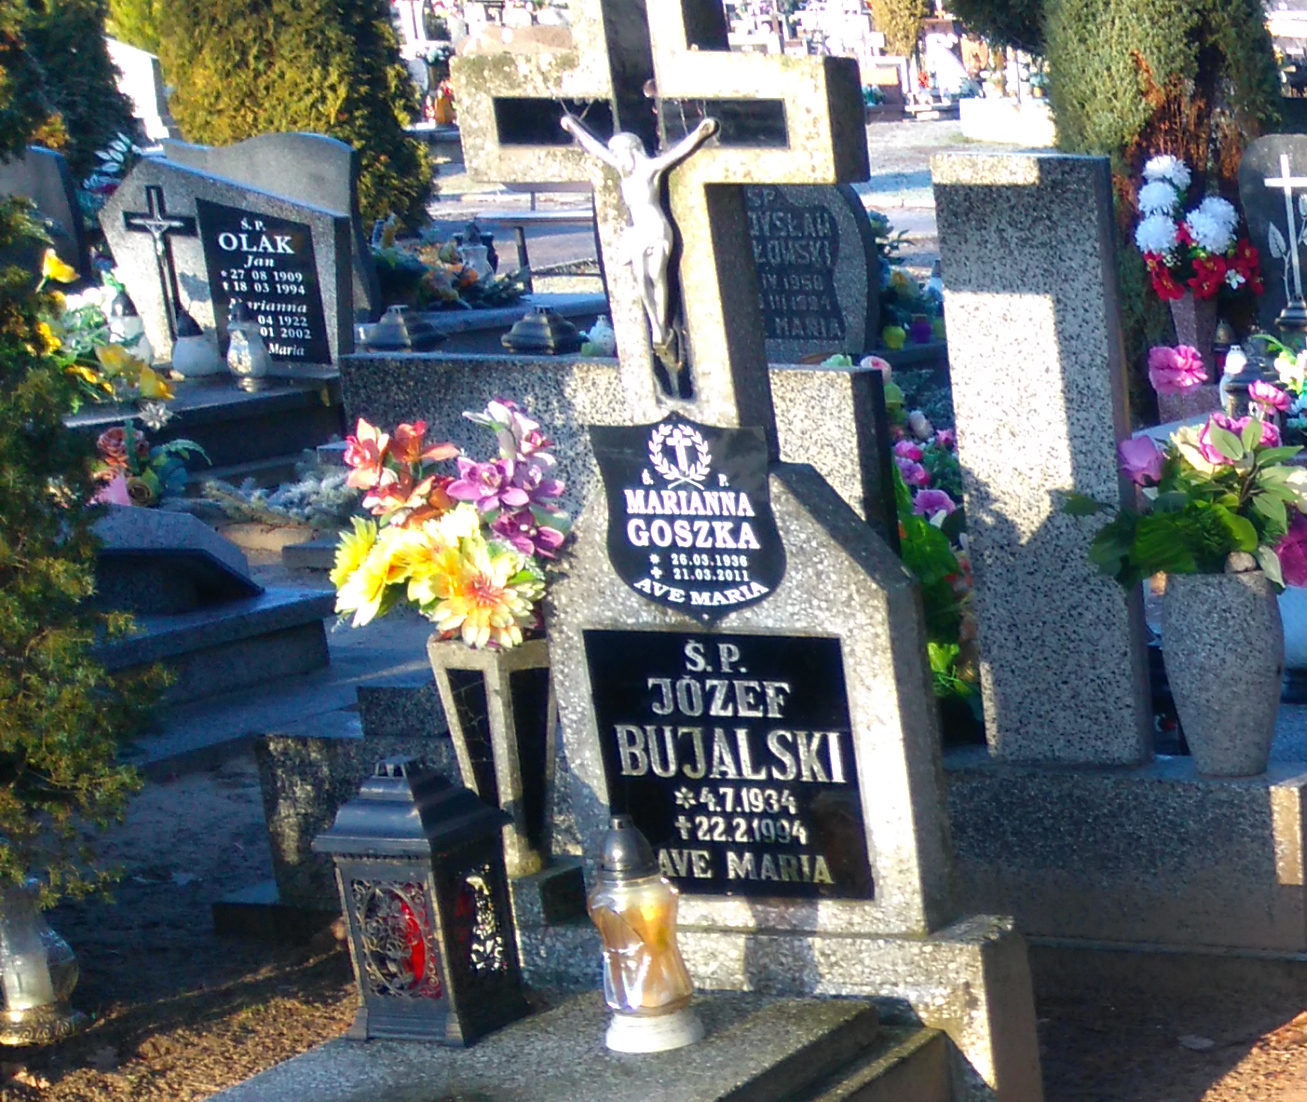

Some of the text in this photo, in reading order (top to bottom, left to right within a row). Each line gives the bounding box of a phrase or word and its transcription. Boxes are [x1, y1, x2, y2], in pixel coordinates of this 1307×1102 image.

[218, 232, 295, 254] OLAK
[243, 256, 275, 268] Jan
[268, 342, 305, 357] Maria
[624, 490, 755, 517] MARIANNA
[627, 520, 760, 549] GOSZKA
[671, 553, 748, 567] 26.03.1936
[673, 568, 749, 582] 21.03.2011
[633, 578, 770, 606] AVE MARIA
[648, 675, 792, 718] JÓZEF
[614, 725, 848, 784] BUJALSKI
[658, 848, 834, 884] AVE MARIA
